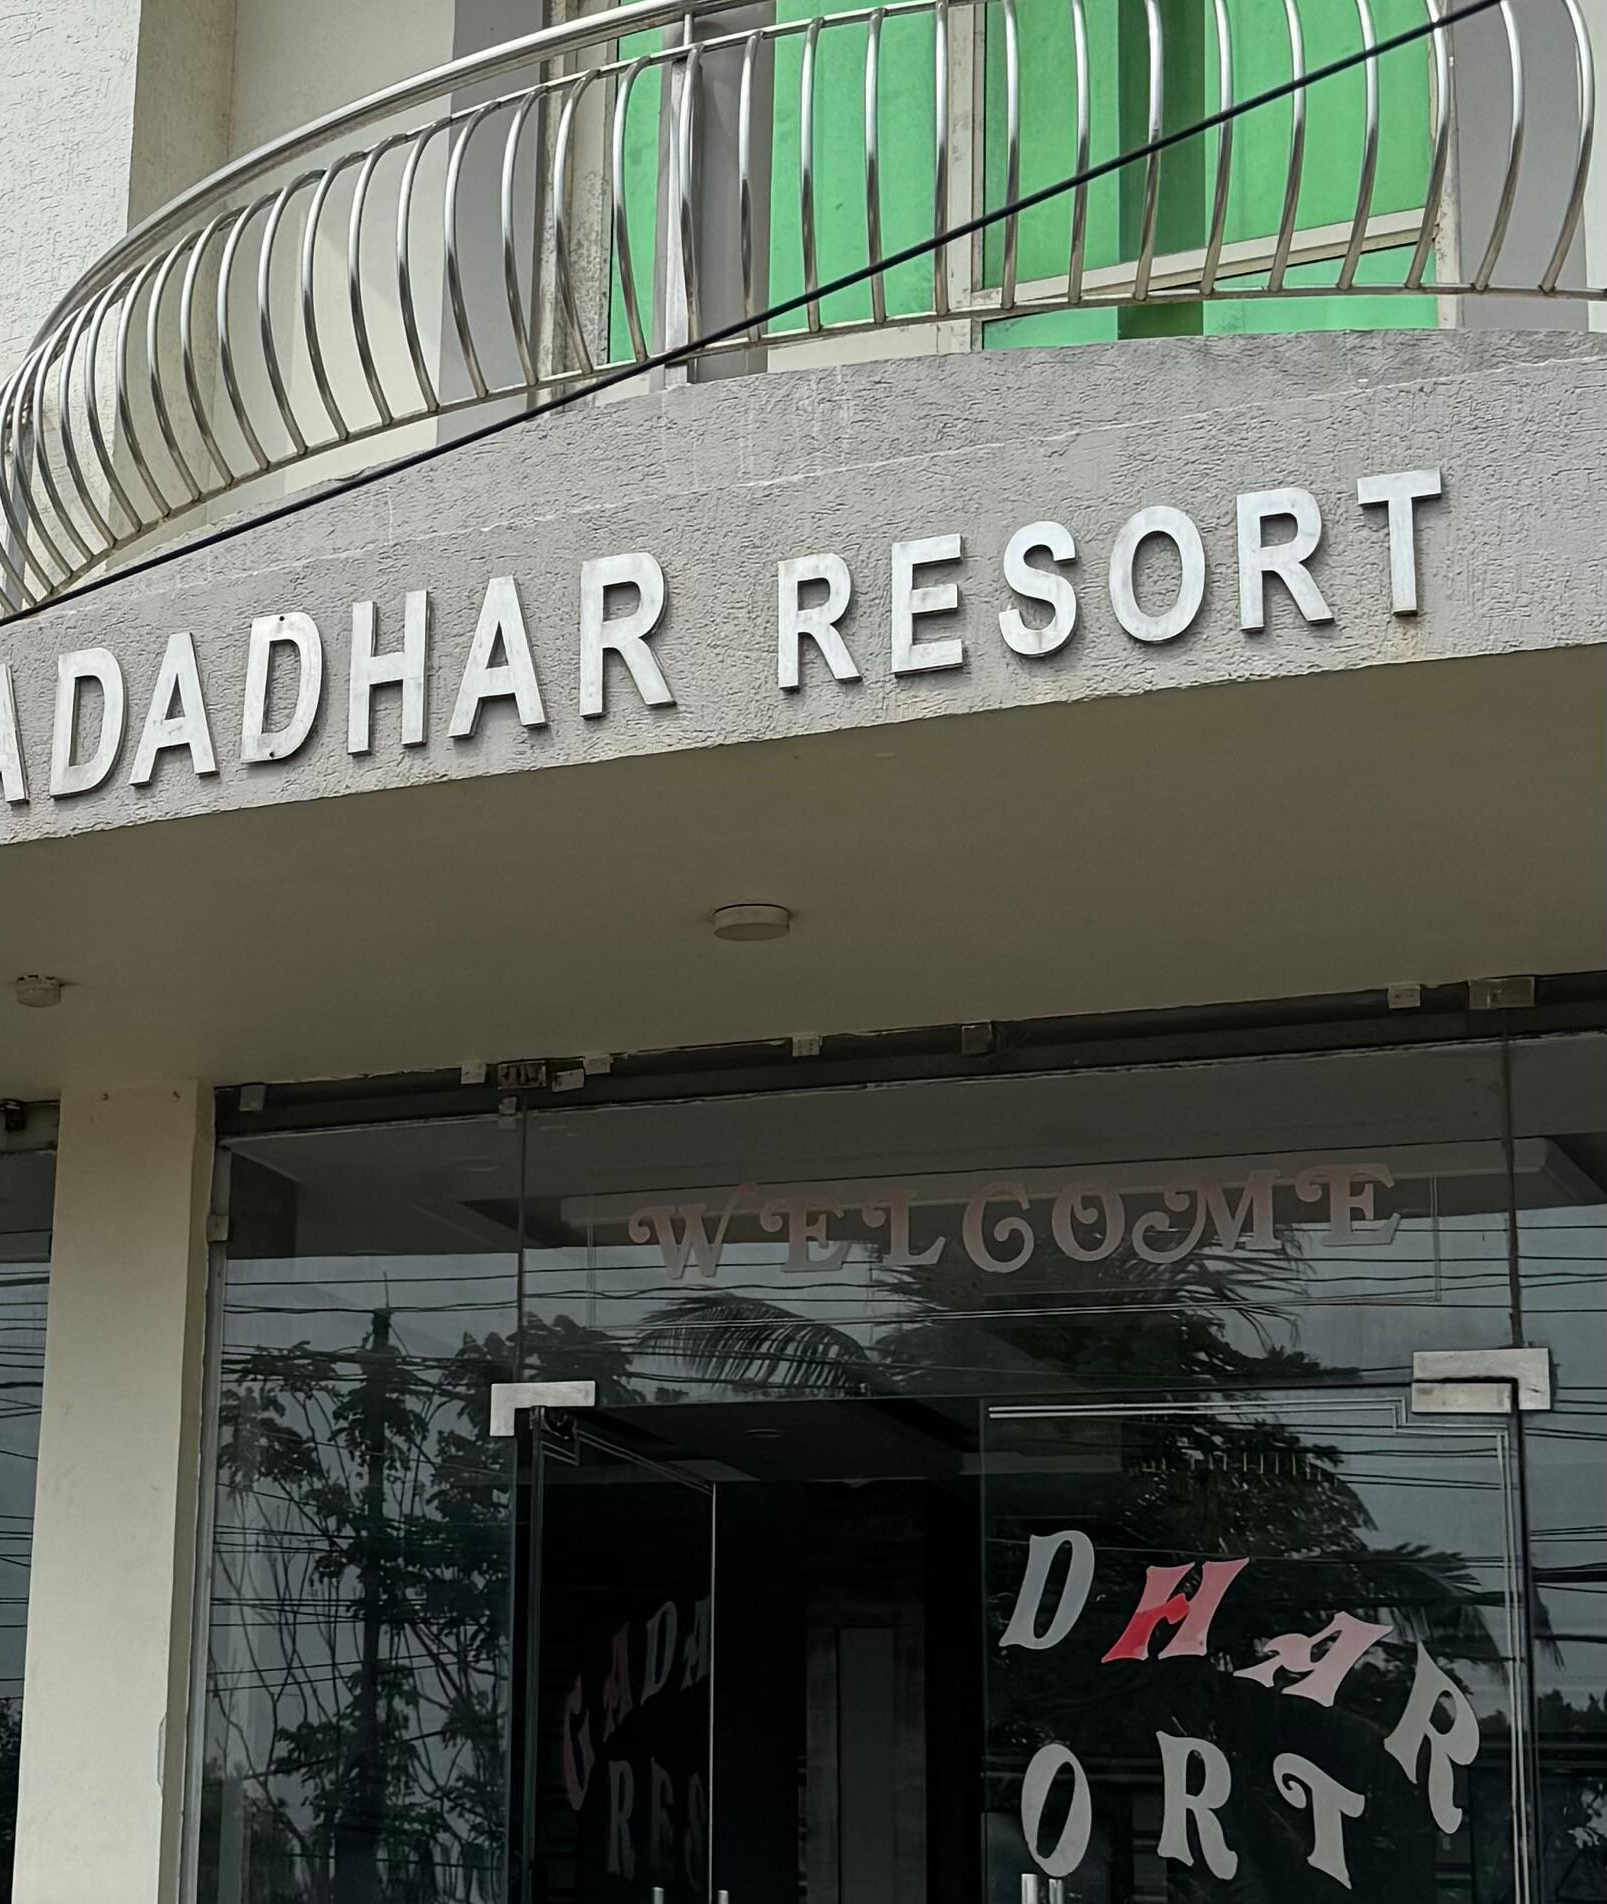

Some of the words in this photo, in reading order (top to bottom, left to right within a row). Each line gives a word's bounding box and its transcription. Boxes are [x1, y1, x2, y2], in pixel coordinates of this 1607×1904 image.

[776, 469, 1445, 690] RESORT
[626, 1162, 1403, 1280] WELCOME
[999, 1528, 1482, 1836] DHAR
[1019, 1729, 1366, 1890] ORT
